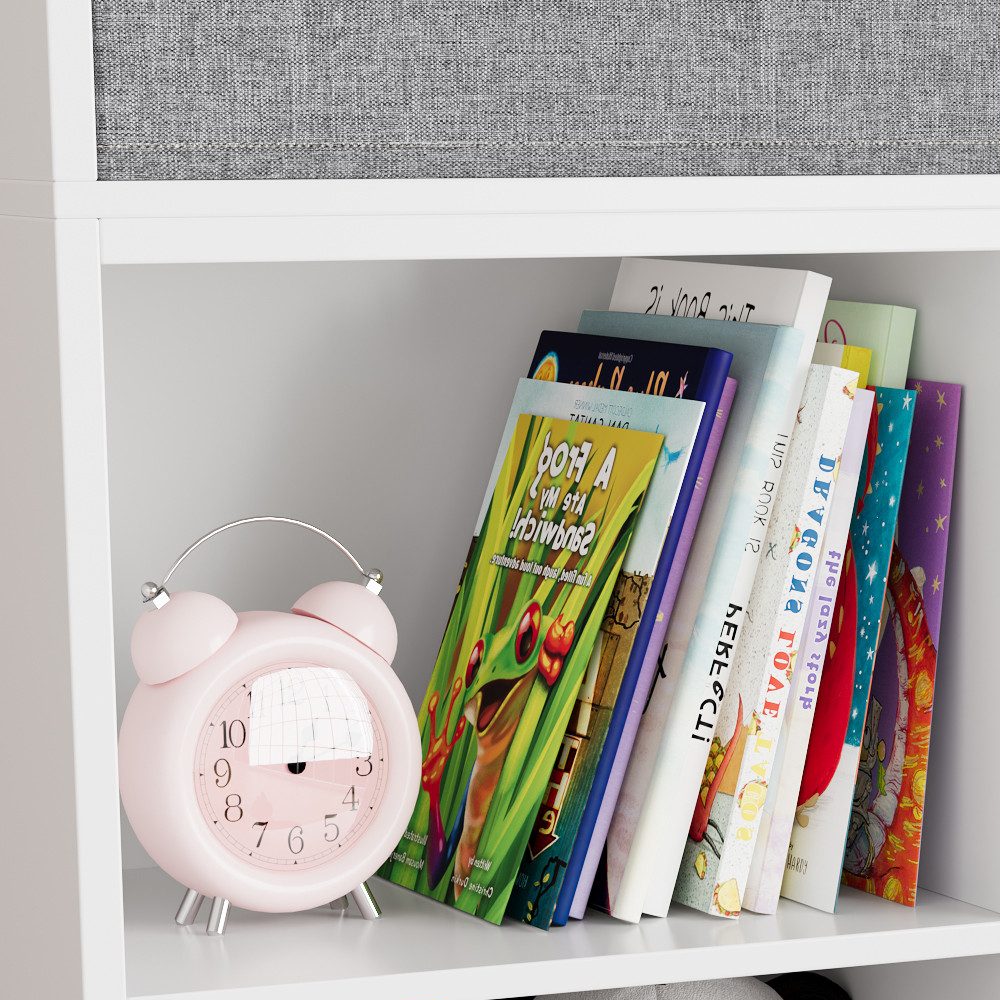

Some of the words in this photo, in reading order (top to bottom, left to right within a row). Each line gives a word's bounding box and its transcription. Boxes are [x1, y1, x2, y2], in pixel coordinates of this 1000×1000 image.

[220, 720, 246, 749] 10
[214, 758, 232, 788] 9
[356, 756, 374, 778] 3
[224, 794, 244, 822] 8
[342, 785, 360, 812] 4
[252, 821, 269, 848] 7
[288, 826, 304, 854] 6
[324, 814, 340, 842] 5
